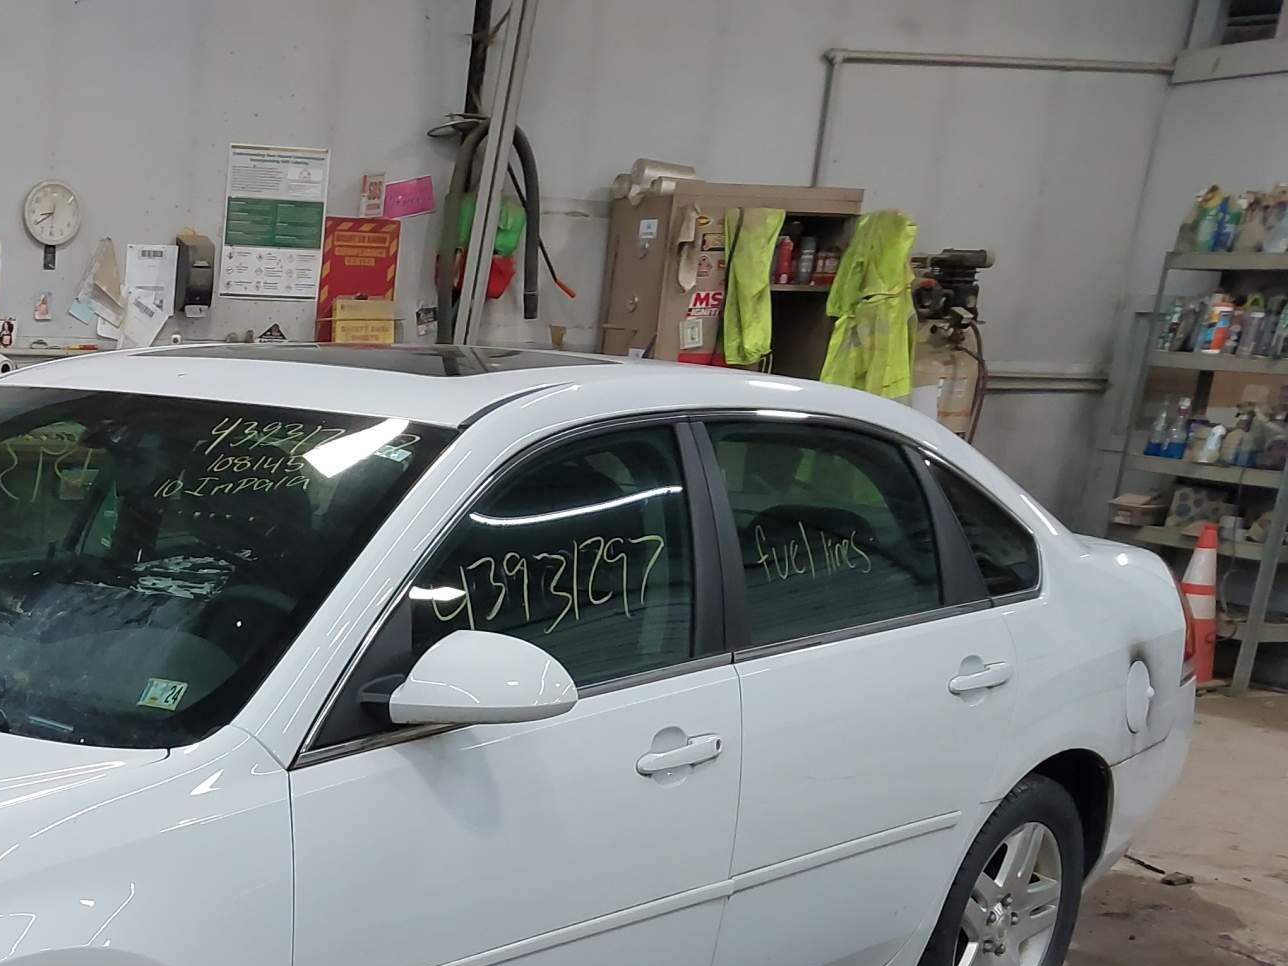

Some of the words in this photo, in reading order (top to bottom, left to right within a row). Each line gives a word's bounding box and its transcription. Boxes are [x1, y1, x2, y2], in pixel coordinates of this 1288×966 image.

[692, 292, 723, 308] MS
[154, 479, 183, 497] 10
[755, 521, 816, 581] fuel
[432, 535, 664, 634] 43931297
[164, 685, 184, 704] 24
